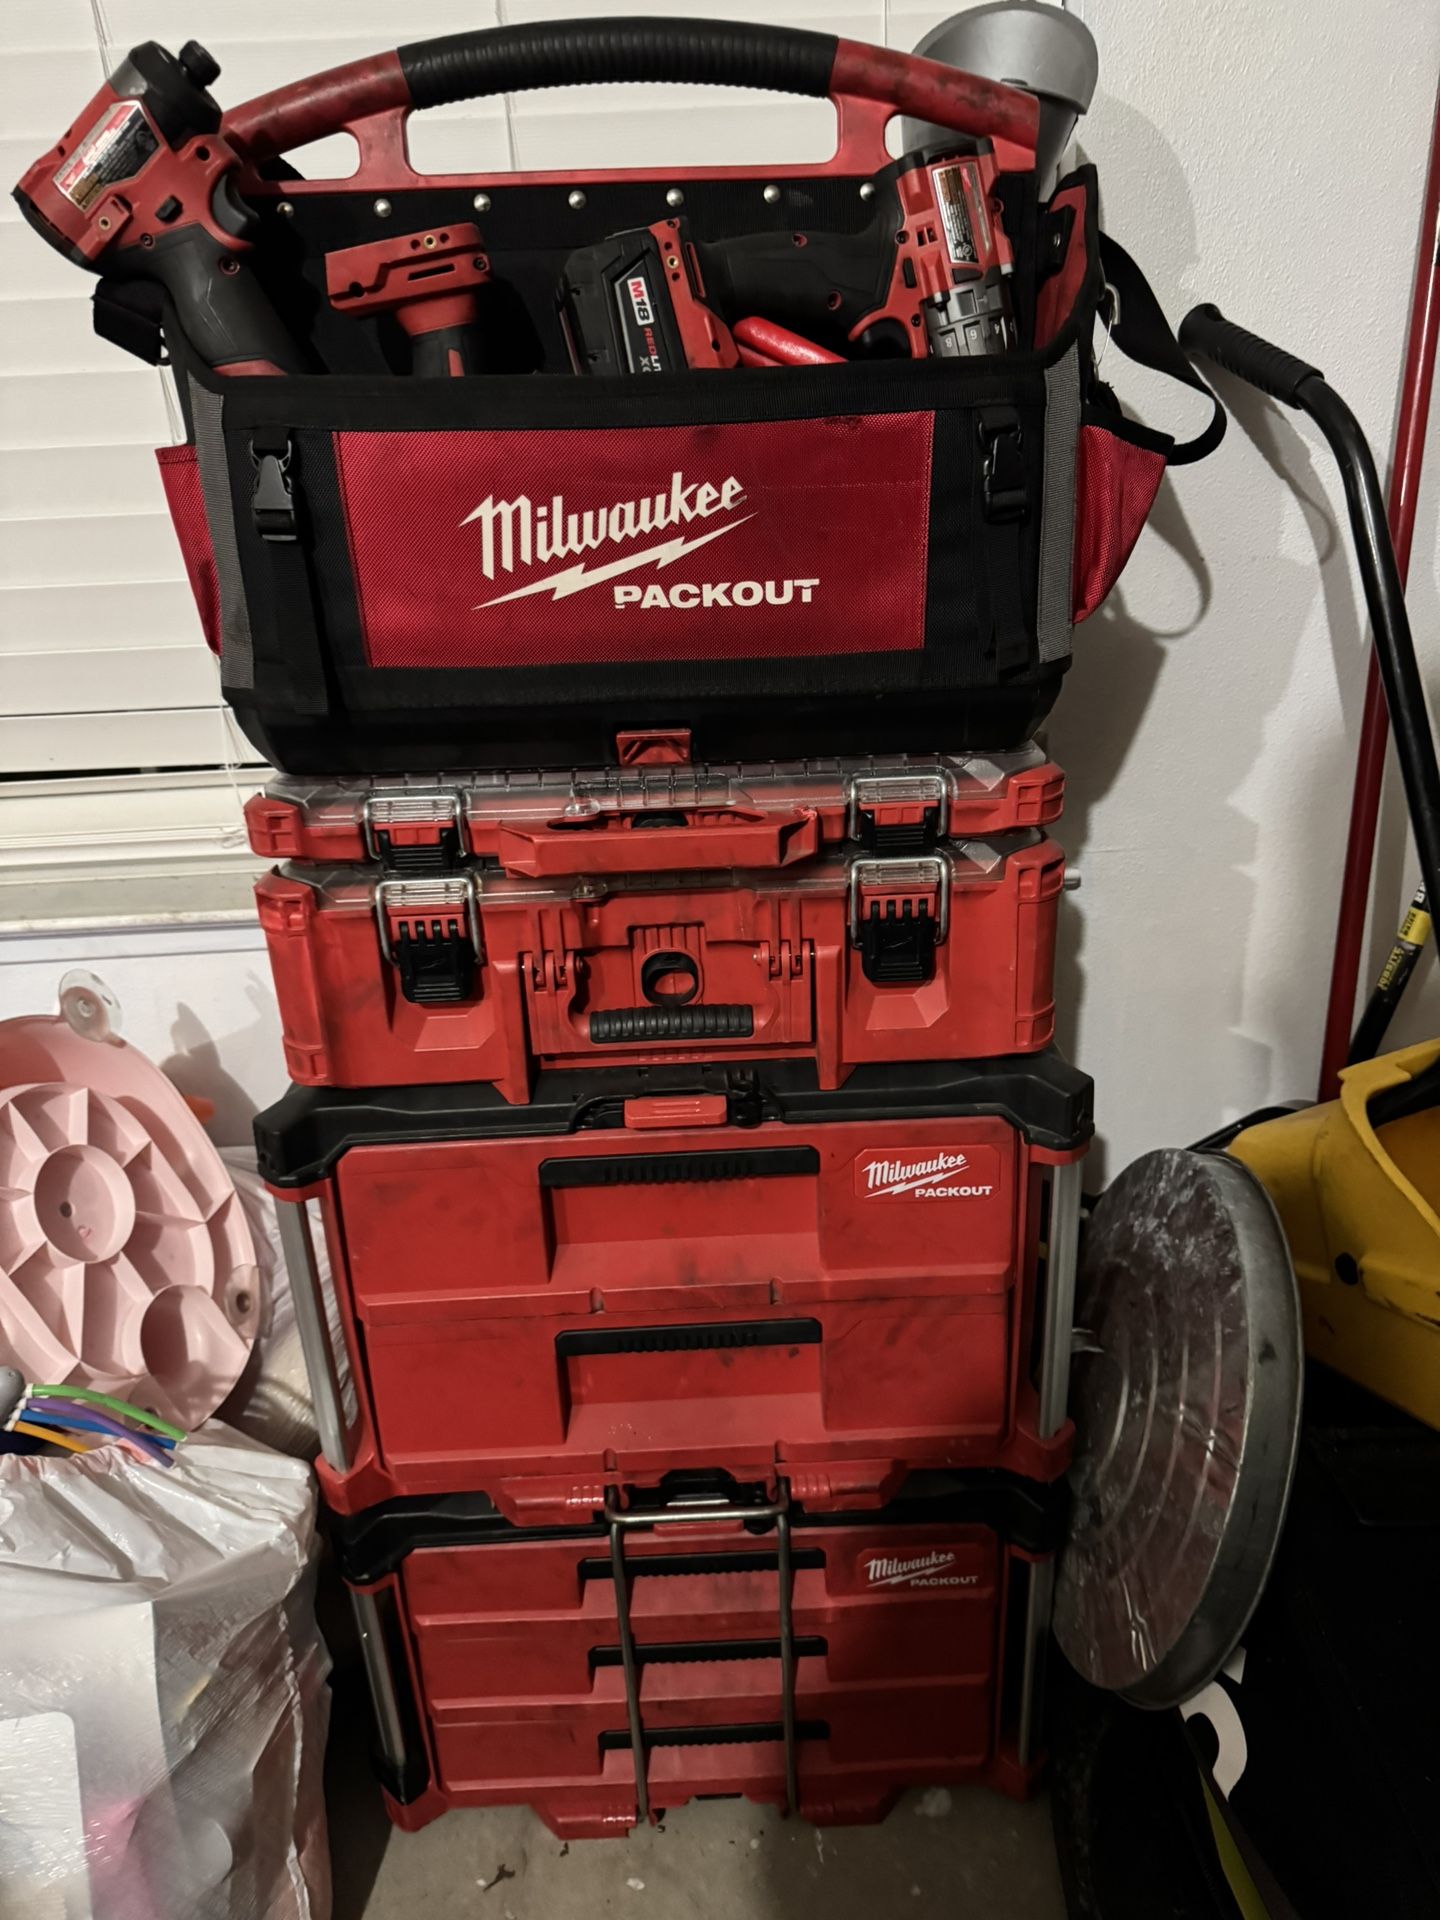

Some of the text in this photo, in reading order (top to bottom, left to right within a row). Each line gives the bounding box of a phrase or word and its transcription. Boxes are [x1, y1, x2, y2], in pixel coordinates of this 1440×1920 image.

[630, 280, 651, 321] M18
[945, 337, 953, 348] 8
[458, 471, 748, 580] Milwaukee
[613, 578, 820, 609] PACKOUT
[862, 1152, 968, 1189] Milwaukee
[914, 1185, 993, 1198] PACKOUT
[863, 1550, 956, 1581] Milwaukee
[909, 1575, 979, 1587] PACKOUT
